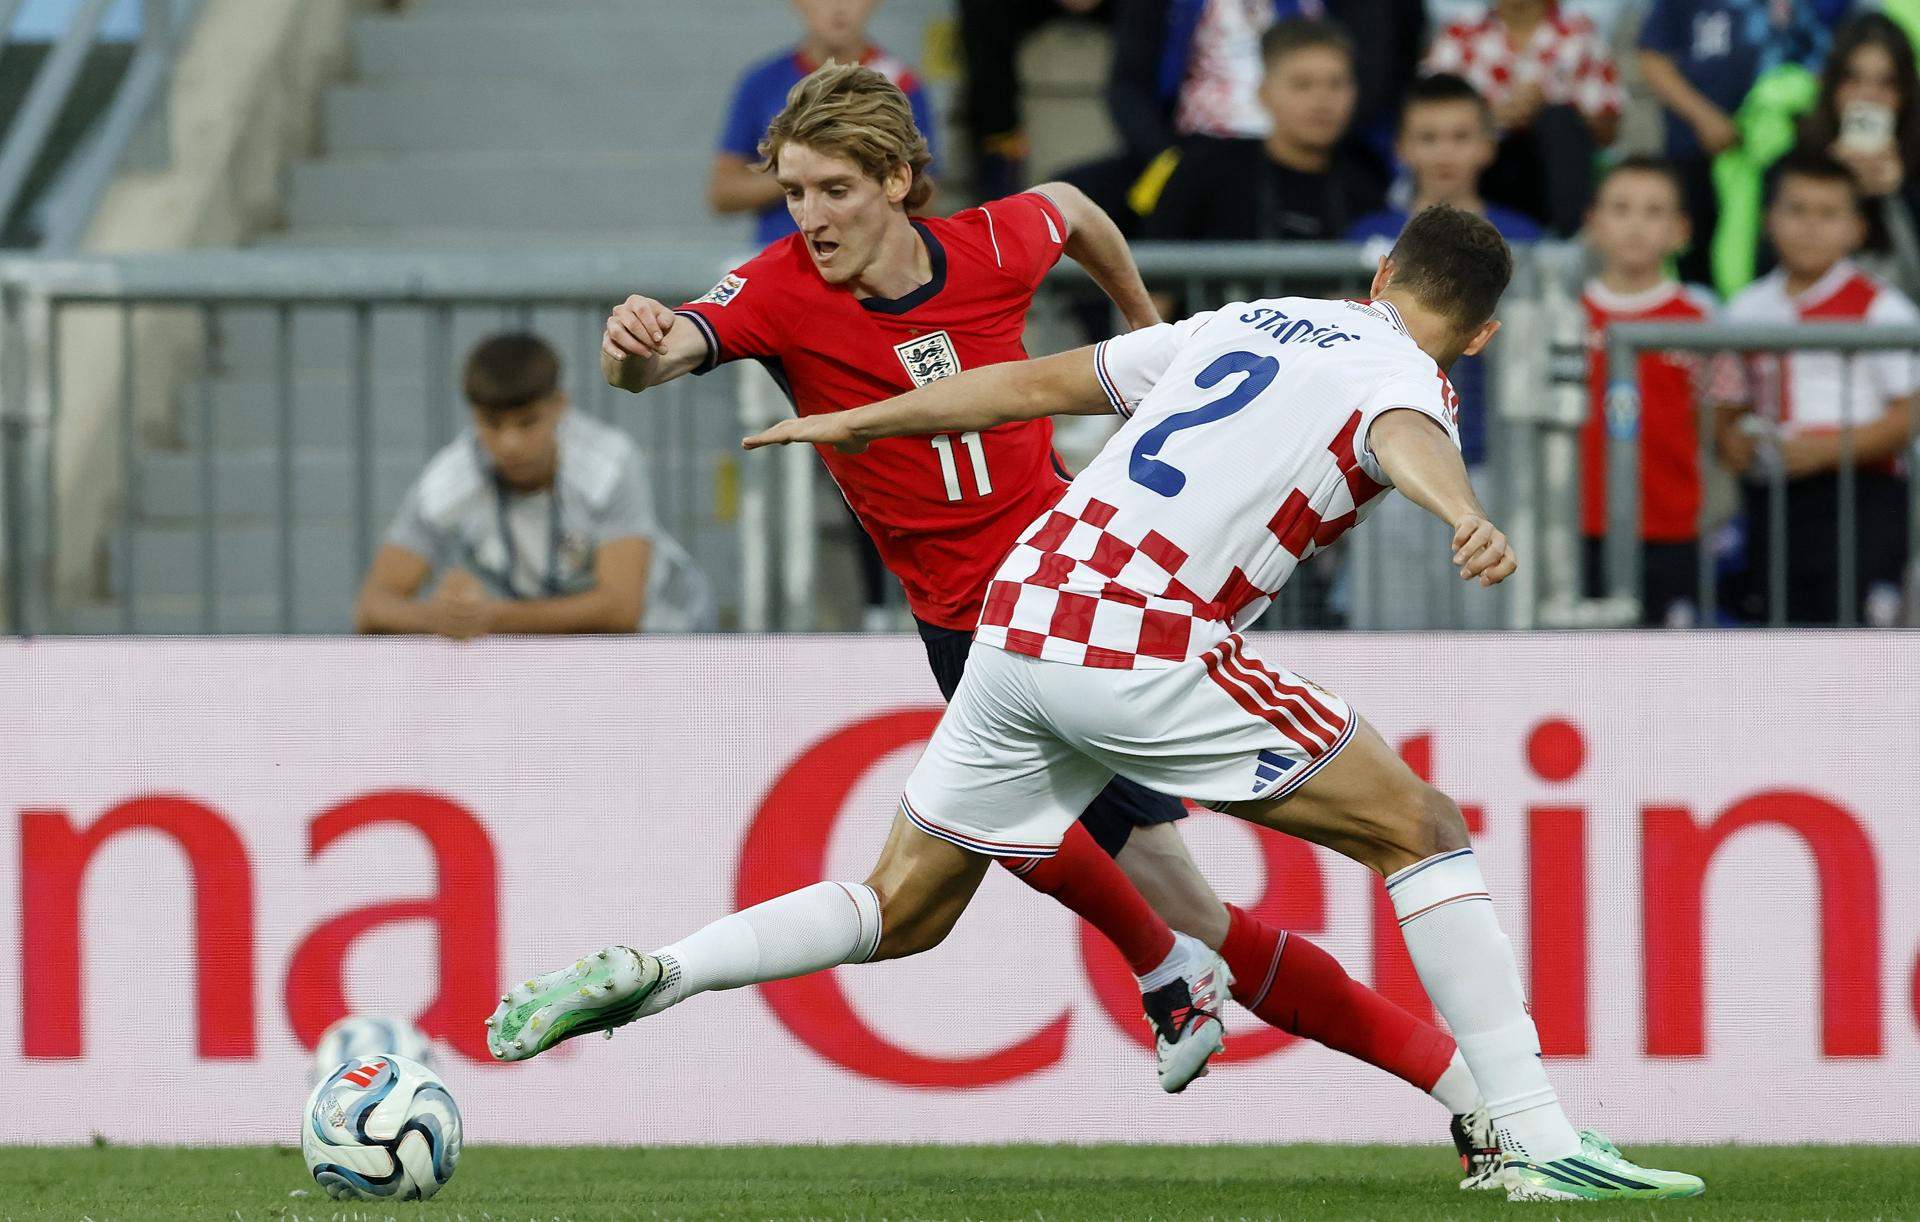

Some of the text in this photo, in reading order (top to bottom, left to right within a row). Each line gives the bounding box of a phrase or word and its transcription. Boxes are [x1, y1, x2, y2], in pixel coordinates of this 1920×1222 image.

[930, 431, 994, 502] 11
[1128, 350, 1280, 498] 2
[734, 706, 1920, 1089] Cetin
